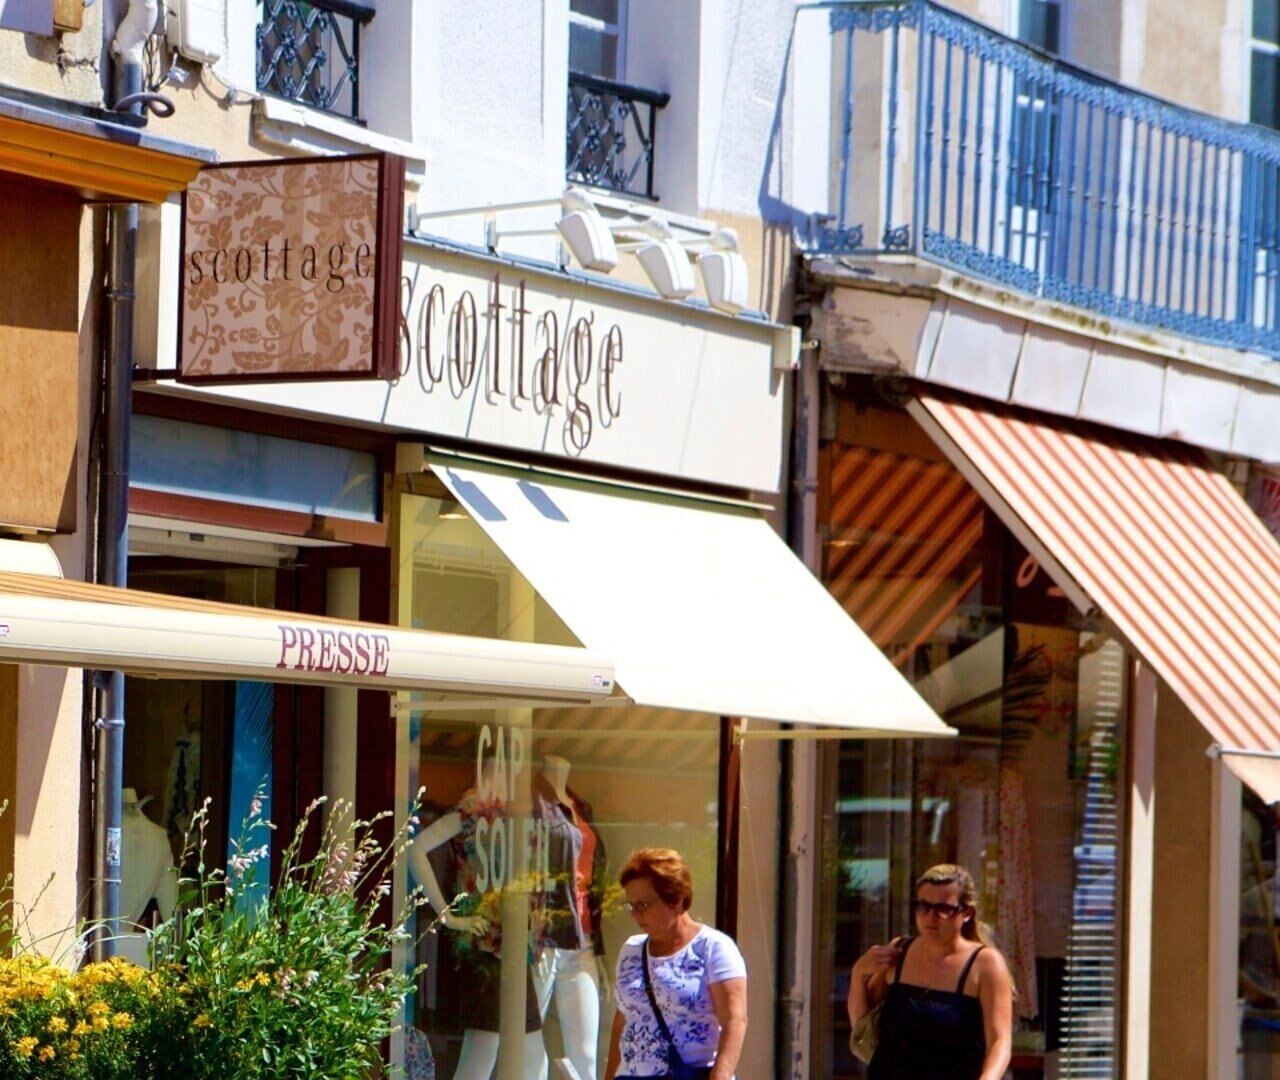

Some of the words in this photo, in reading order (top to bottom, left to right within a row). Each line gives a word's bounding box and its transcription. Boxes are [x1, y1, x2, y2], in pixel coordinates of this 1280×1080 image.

[189, 239, 372, 292] scottage
[276, 625, 390, 677] PRESSE
[477, 724, 524, 807] CAP
[476, 816, 557, 894] SOLEIL
